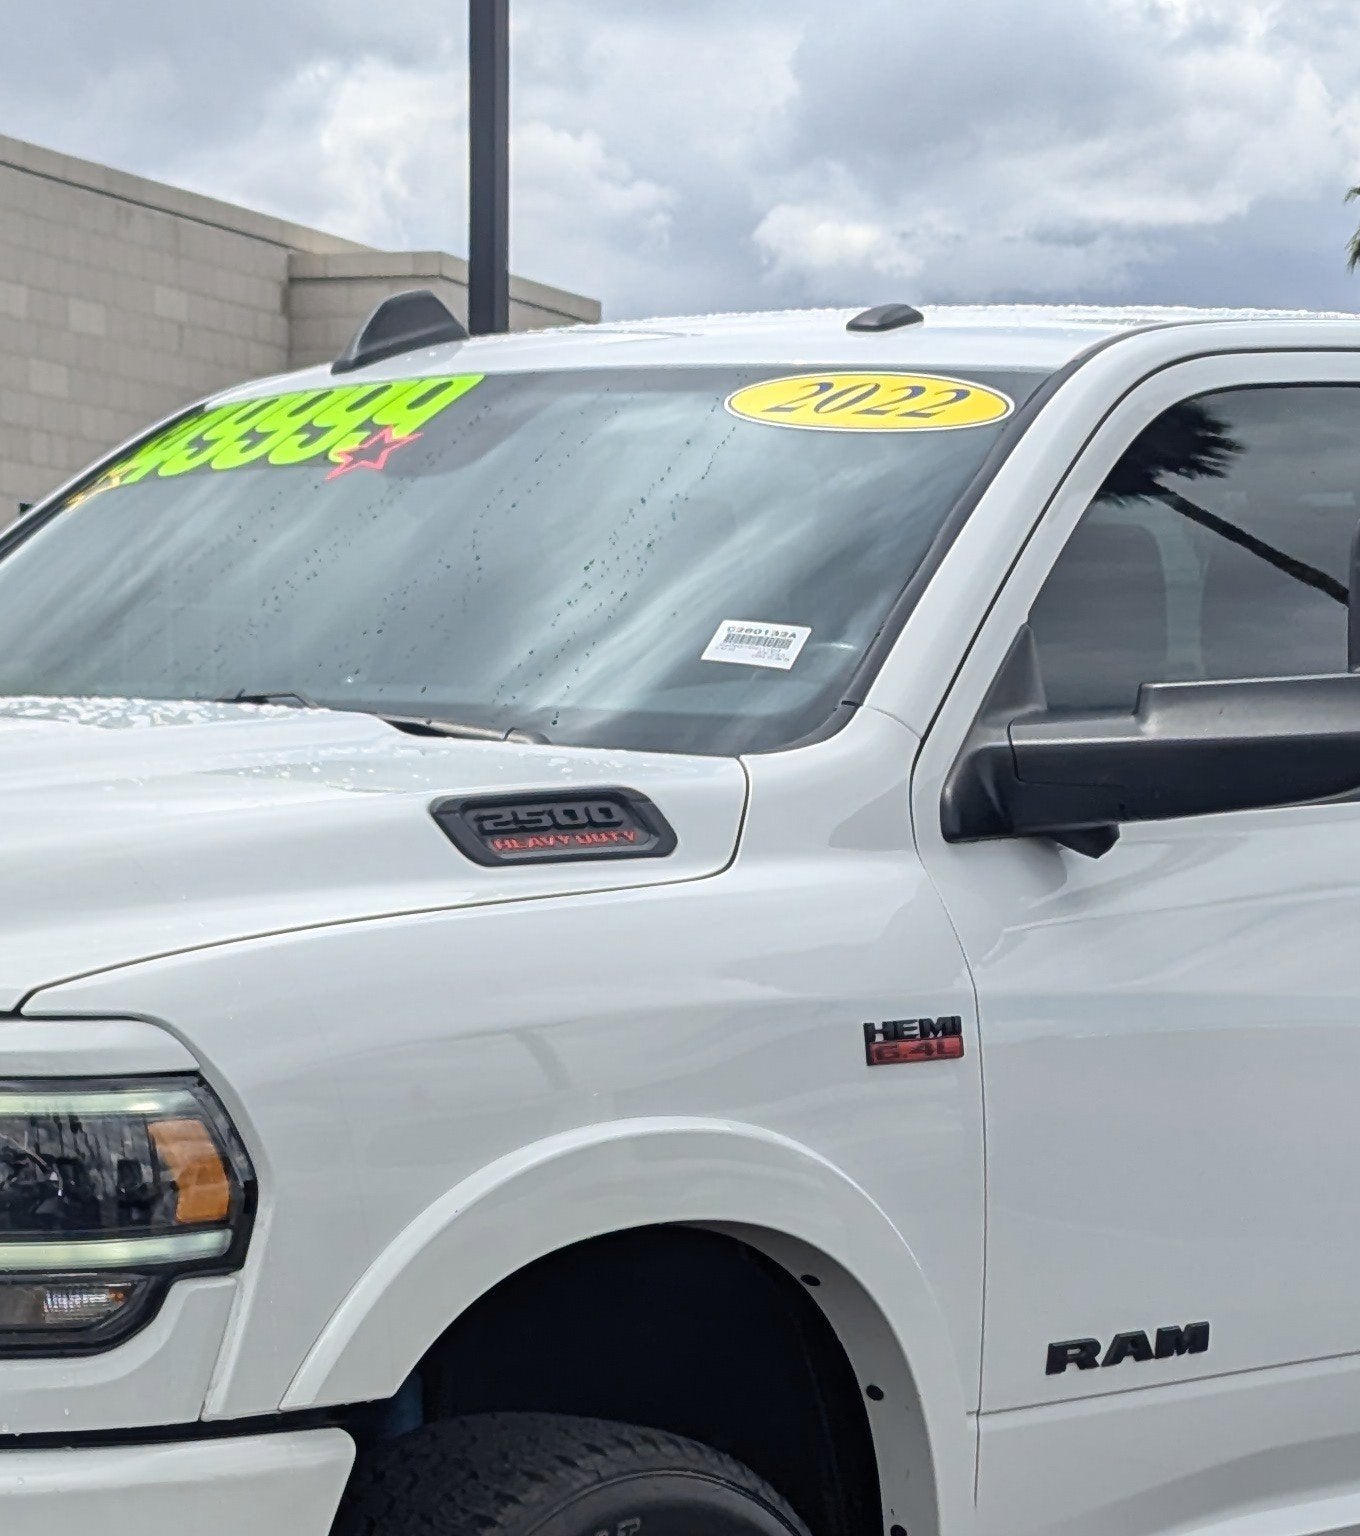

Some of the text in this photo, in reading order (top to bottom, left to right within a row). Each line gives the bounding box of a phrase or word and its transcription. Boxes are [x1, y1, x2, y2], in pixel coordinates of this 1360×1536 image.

[761, 381, 971, 419] 2022
[474, 805, 625, 835] 2500
[492, 831, 637, 851] HEAVY DUTY
[863, 1016, 962, 1043] HEMI
[1045, 1321, 1210, 1375] RAM
